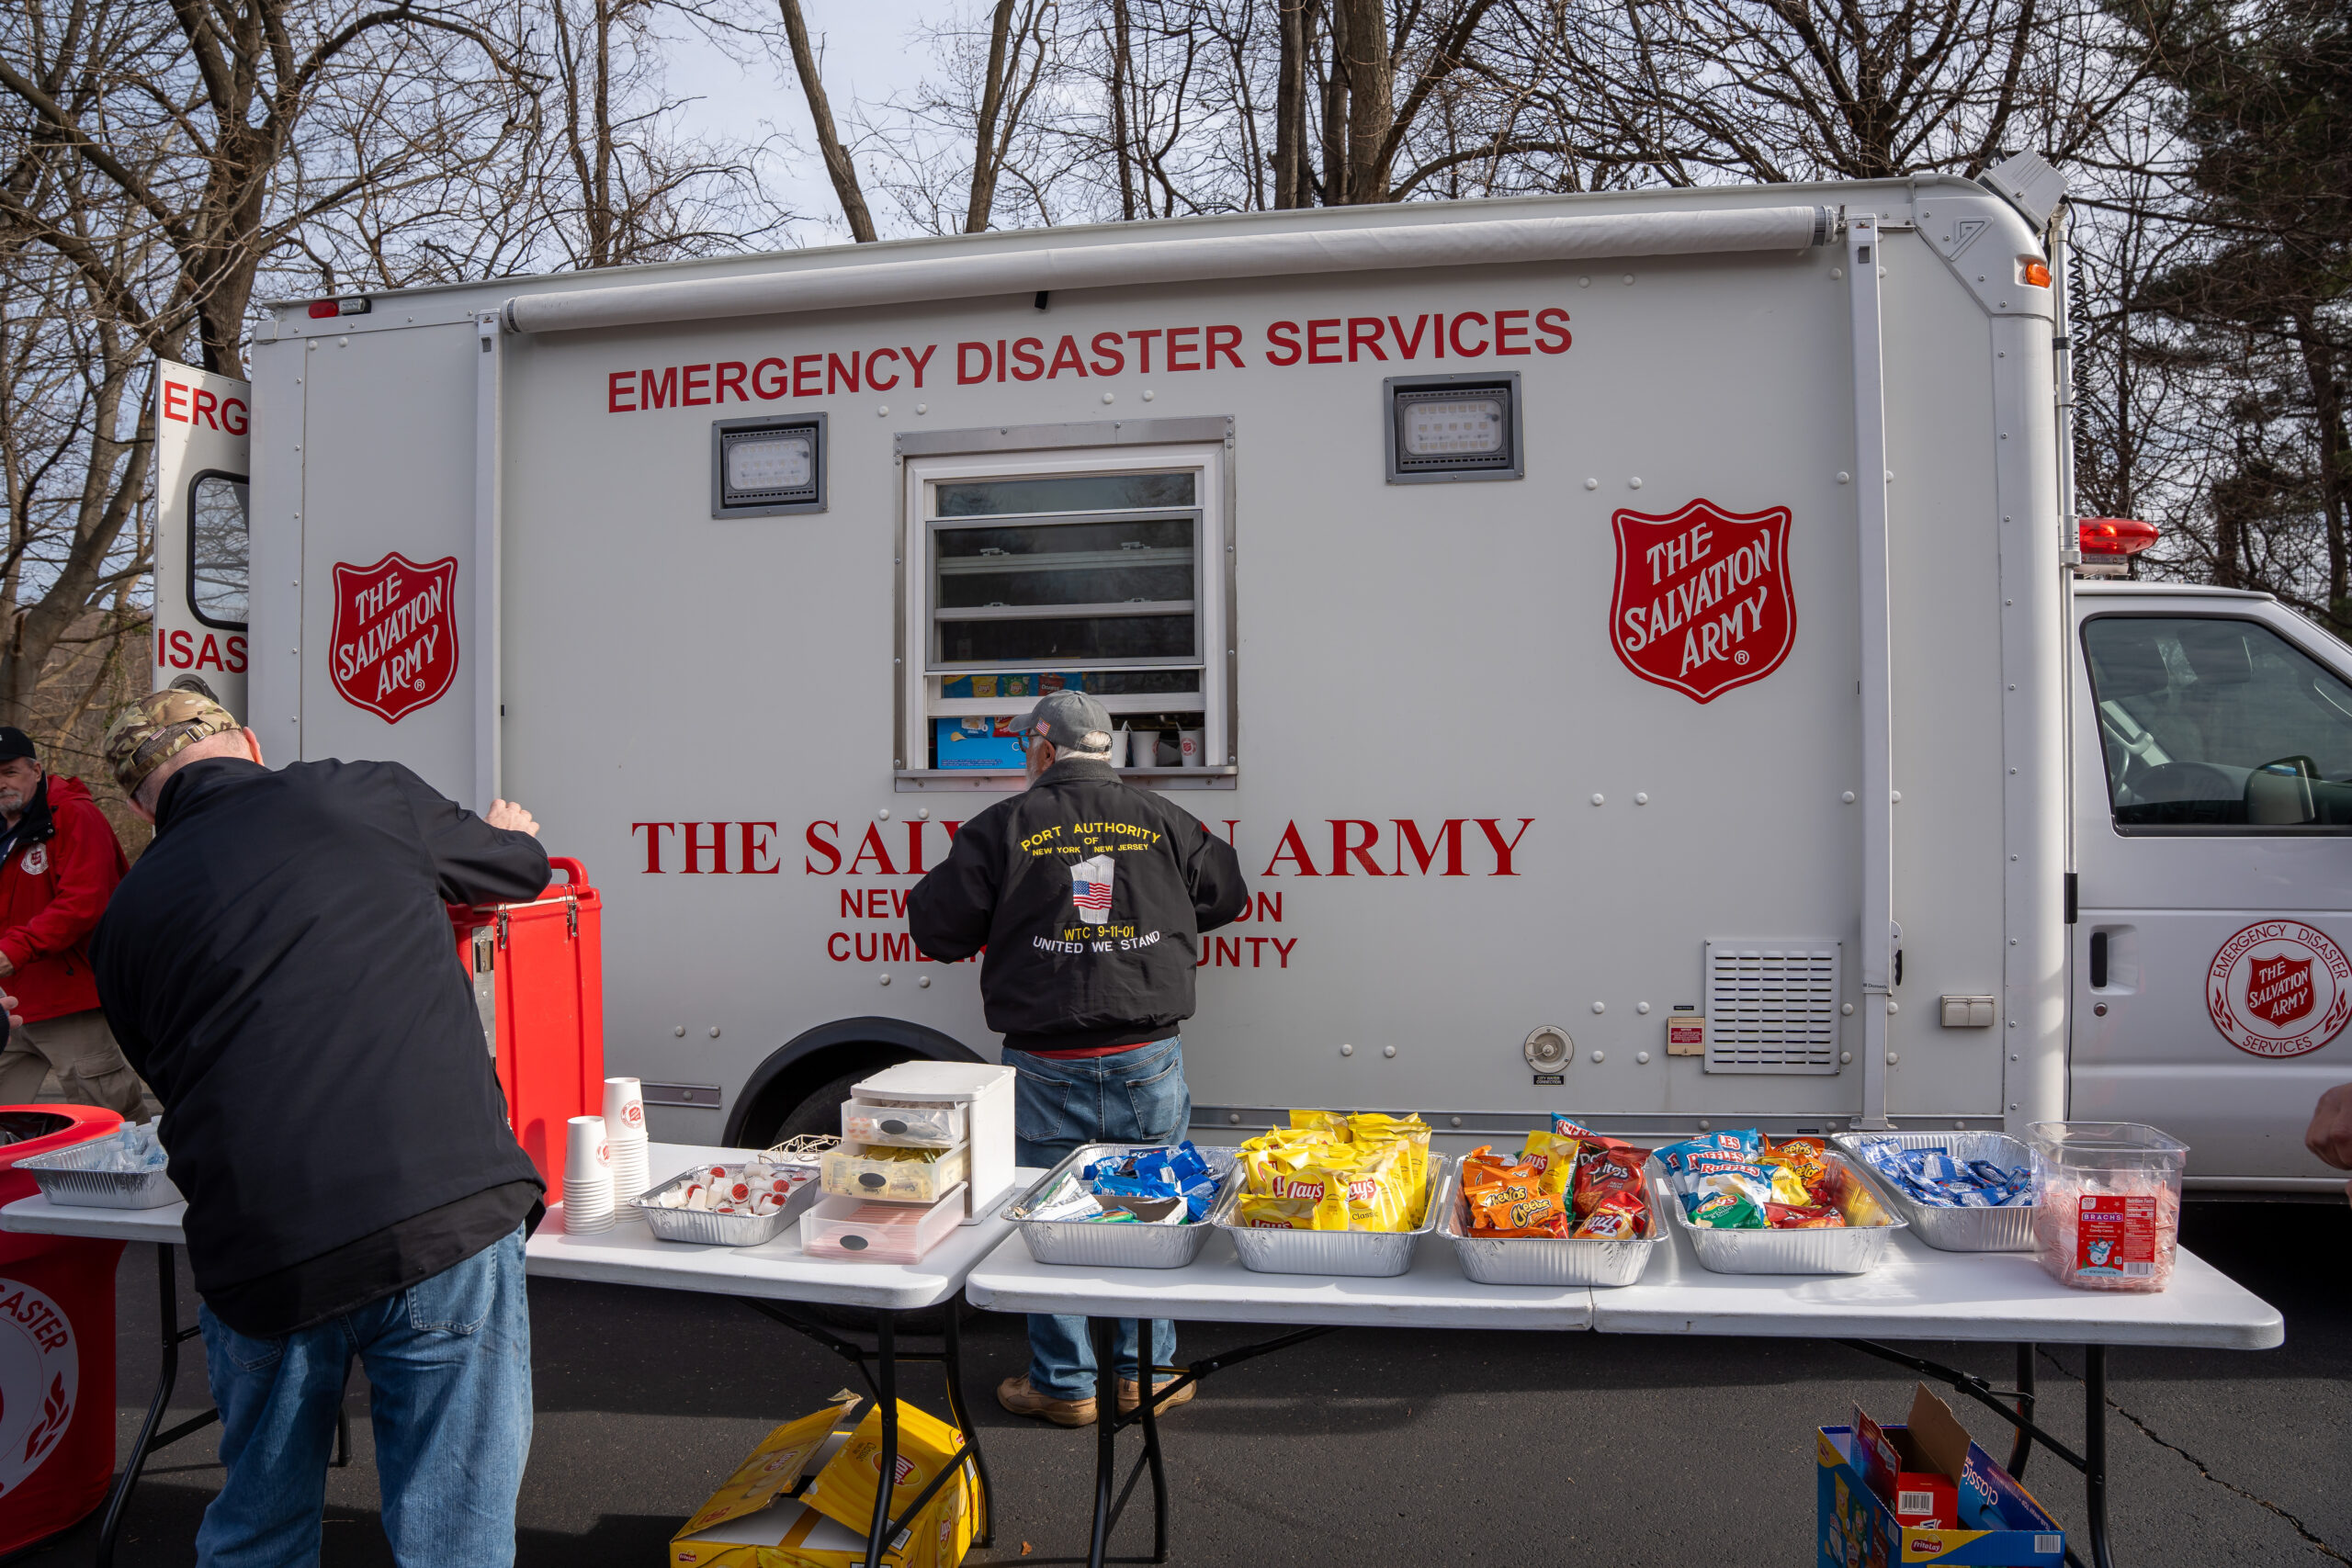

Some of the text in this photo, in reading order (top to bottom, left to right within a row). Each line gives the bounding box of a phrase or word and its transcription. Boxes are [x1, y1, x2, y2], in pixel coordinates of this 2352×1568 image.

[608, 308, 1573, 413] EMERGENCY DISASTER SERVICES
[1646, 522, 1713, 585] THE
[356, 571, 402, 626] THE
[1624, 528, 1771, 651] SALVATION
[339, 576, 442, 681] SALVATION
[1679, 585, 1768, 678] ARMY
[376, 624, 439, 703] ARMY
[631, 821, 780, 874] THE
[1261, 818, 1535, 877] ARMY
[1021, 822, 1161, 852] PORT AUTHORITY
[1032, 843, 1148, 856] NEW YORK NEW JERSEY
[1083, 837, 1099, 845] OF
[1033, 931, 1160, 953] UNITED WE STAND
[1064, 925, 1135, 942] WTC 9-11-01
[2212, 924, 2349, 980] EMERGENCY DISASTER
[2249, 966, 2309, 1009] SALVATION
[2258, 961, 2286, 984] THE
[2270, 987, 2308, 1019] ARMY
[2243, 1035, 2312, 1054] SERVICES
[1702, 1164, 1760, 1177] RUFFLES
[1288, 1179, 1324, 1201] Lay's
[1347, 1178, 1375, 1200] ay's
[1511, 1199, 1552, 1227] Cheetos
[1962, 1462, 1999, 1506] classic
